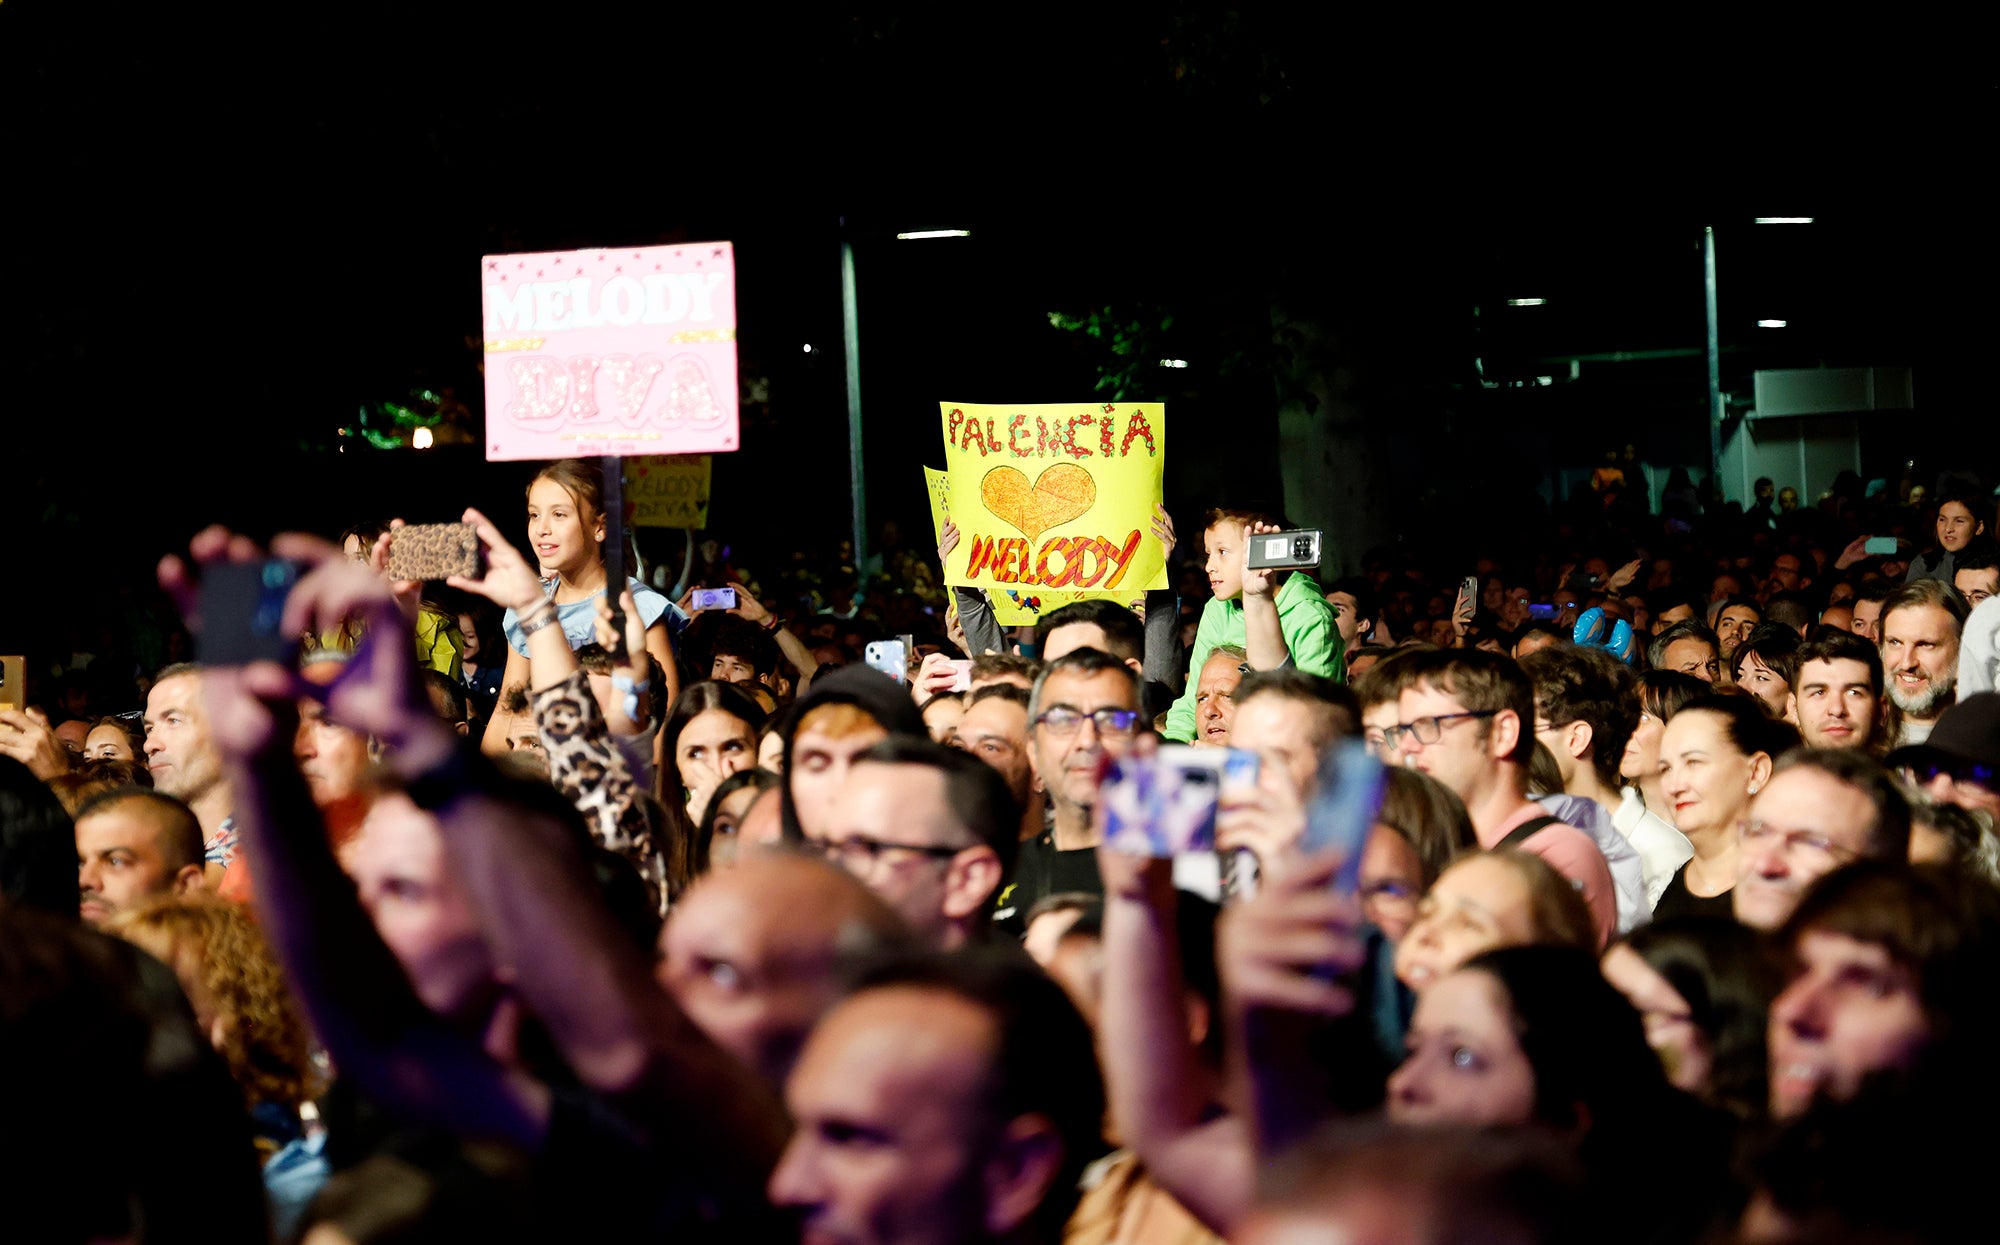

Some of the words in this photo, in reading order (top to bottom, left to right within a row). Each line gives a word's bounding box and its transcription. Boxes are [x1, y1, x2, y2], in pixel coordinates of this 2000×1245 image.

[486, 272, 725, 332] MELODY
[507, 355, 724, 424] DIVA
[965, 529, 1142, 590] MELODY
